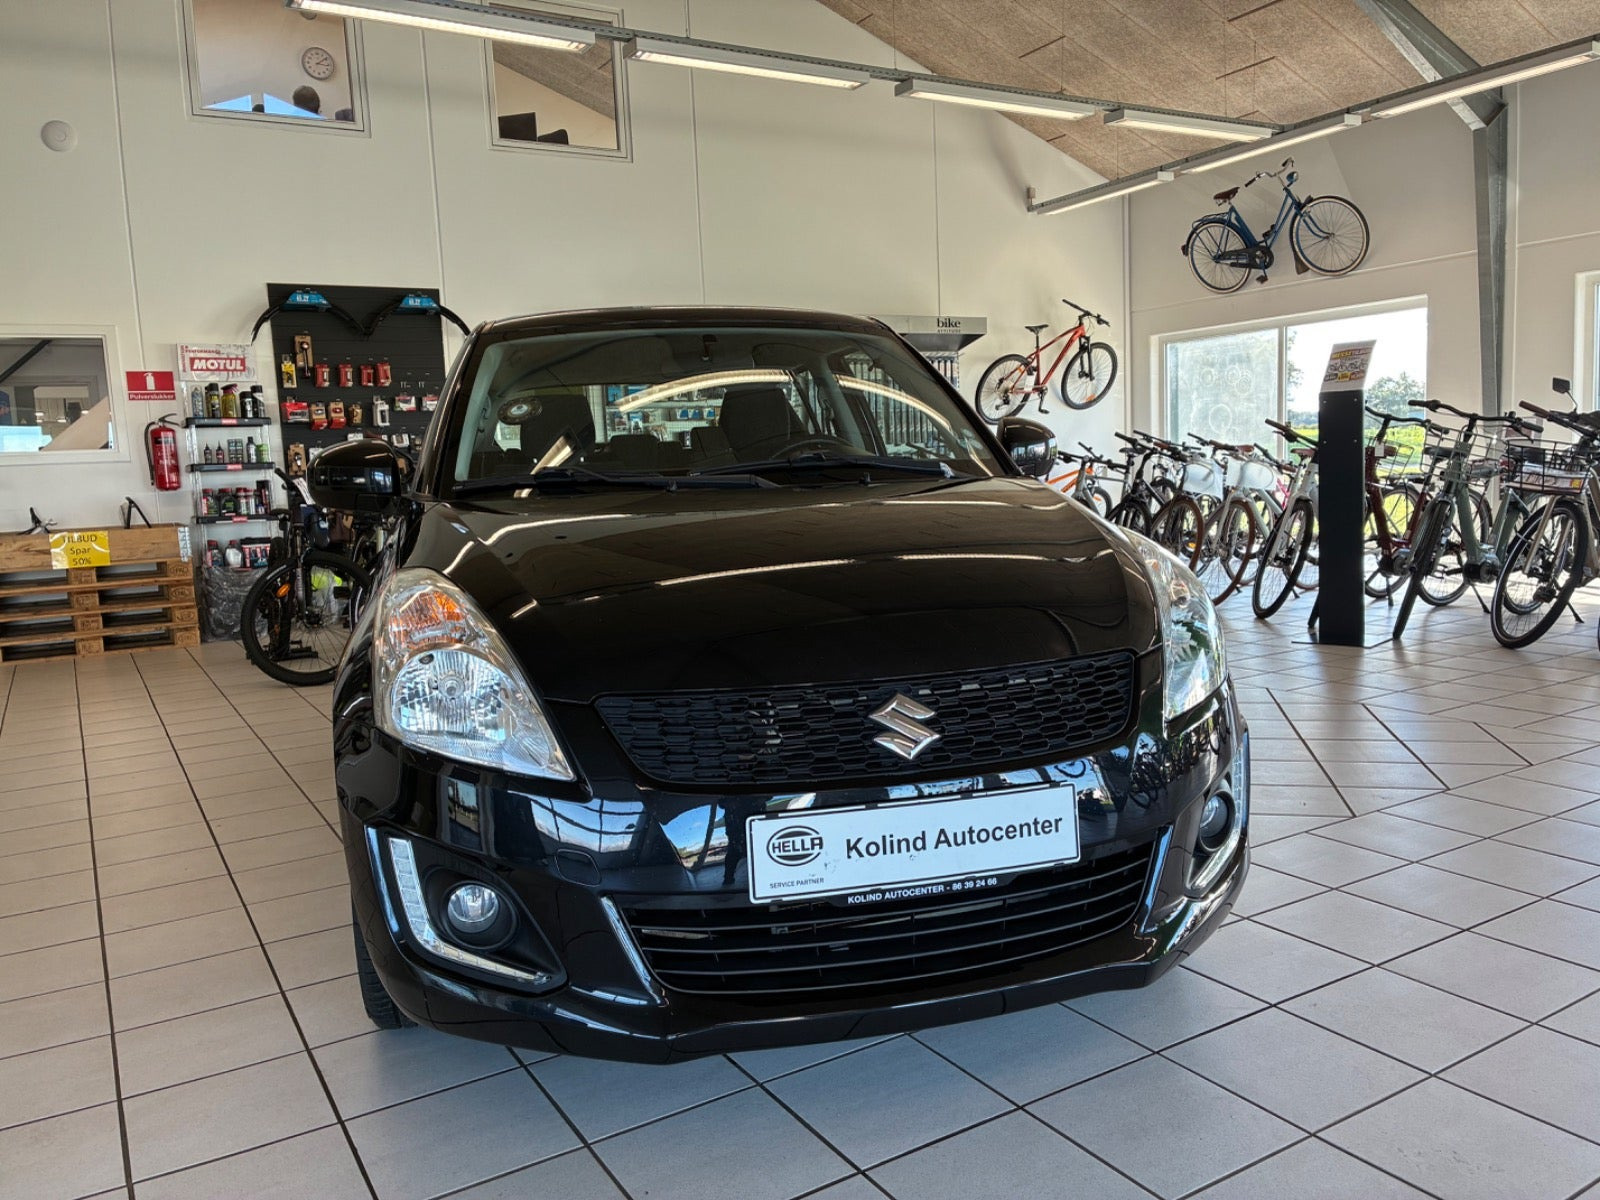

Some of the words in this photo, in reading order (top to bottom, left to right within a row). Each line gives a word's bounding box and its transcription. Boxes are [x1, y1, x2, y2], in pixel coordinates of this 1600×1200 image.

[937, 317, 961, 328] bike
[193, 359, 243, 370] MOTUL
[70, 547, 91, 556] Spar
[73, 557, 92, 566] 50%
[846, 830, 927, 859] Kolind
[934, 817, 1063, 850] Autocenter
[771, 836, 824, 854] HELLA
[796, 877, 825, 887] PARTNER
[847, 894, 882, 904] KOLIND
[885, 885, 945, 899] AUTOCENTER
[964, 879, 975, 889] 39
[976, 878, 987, 888] 24
